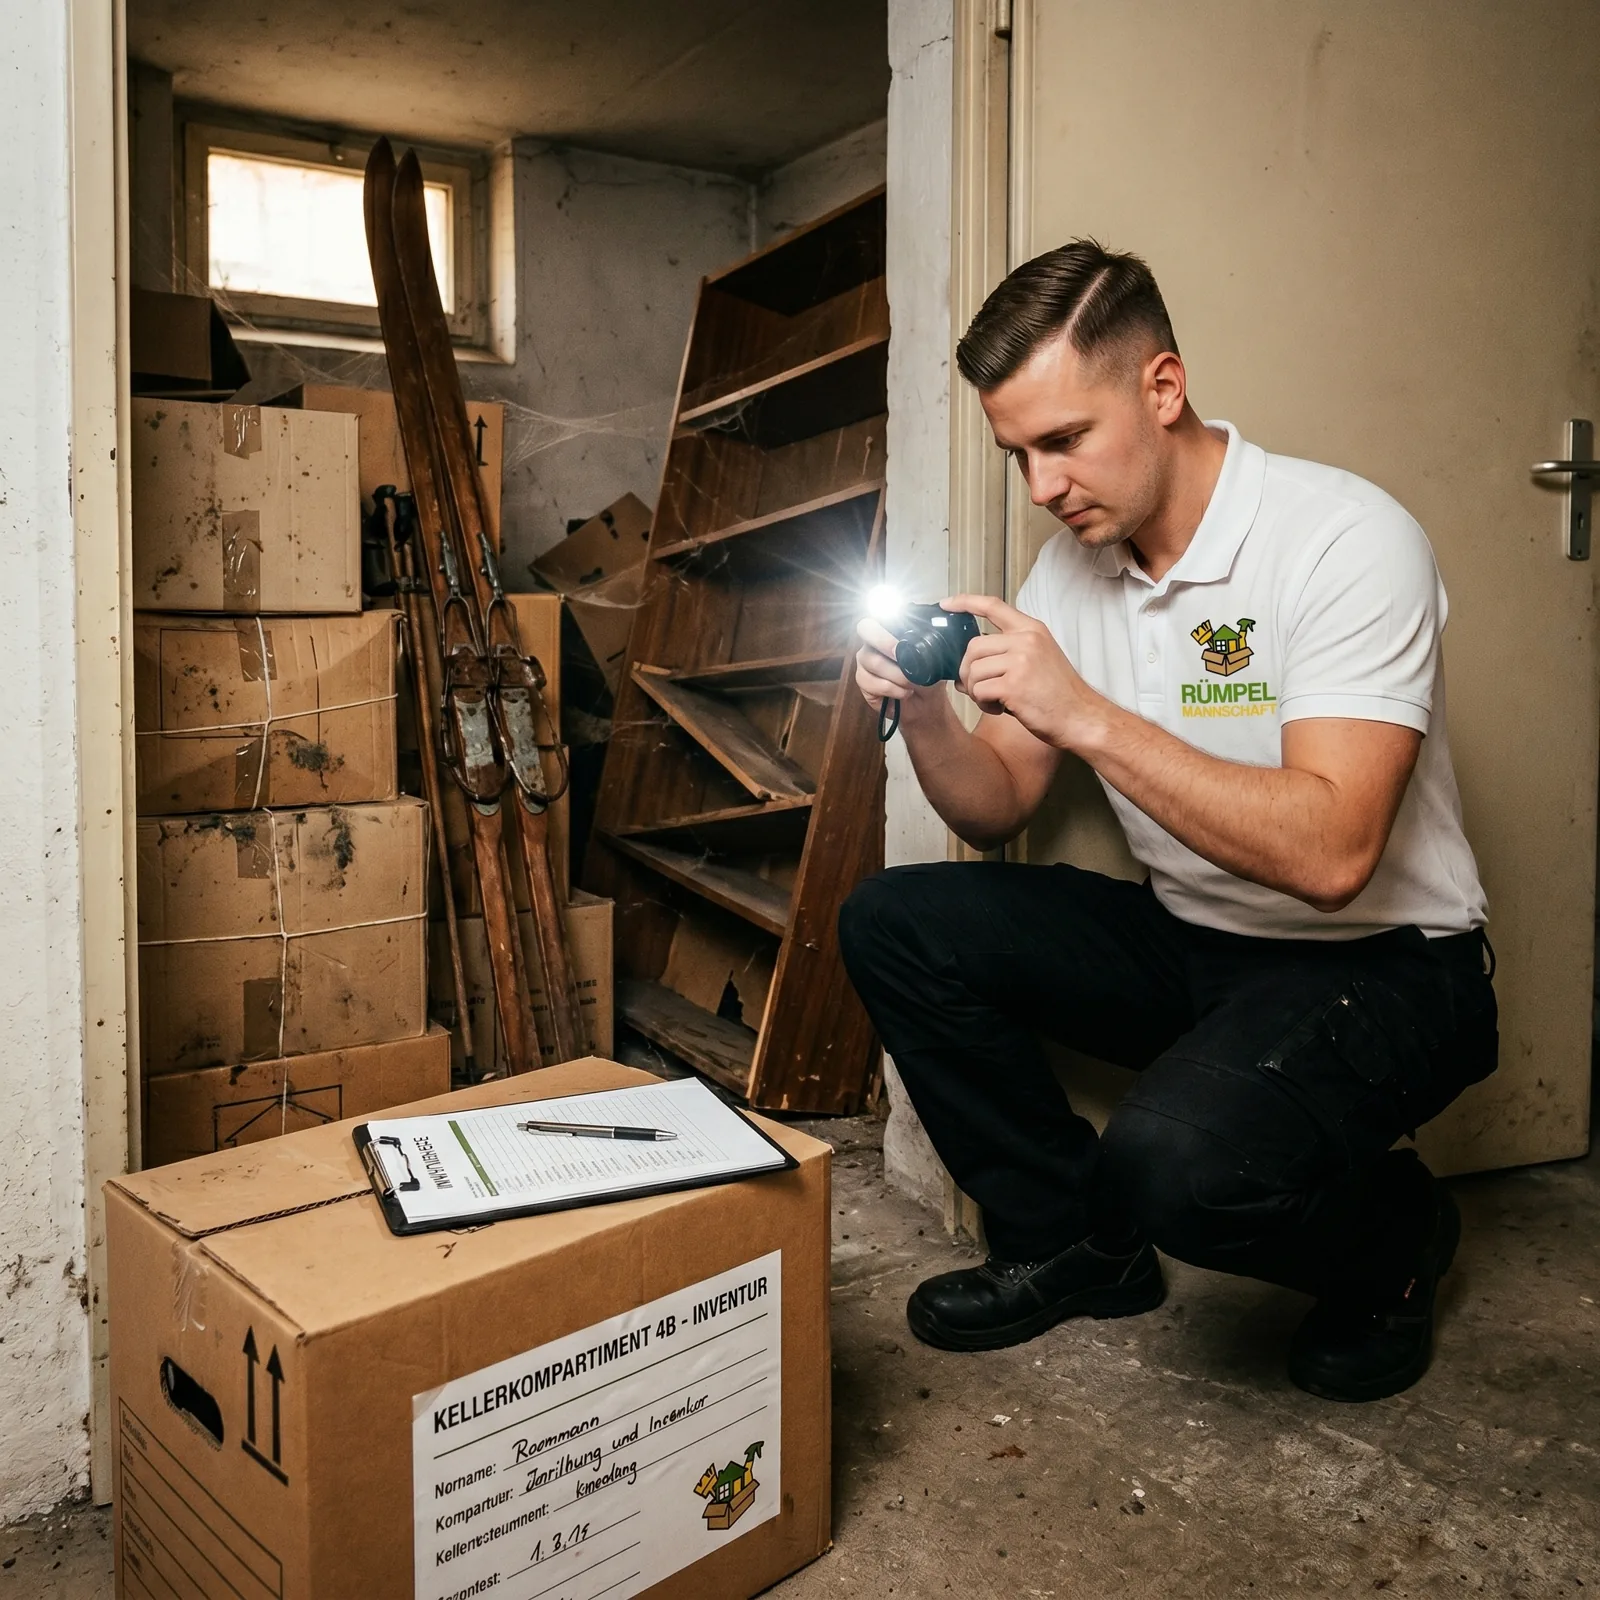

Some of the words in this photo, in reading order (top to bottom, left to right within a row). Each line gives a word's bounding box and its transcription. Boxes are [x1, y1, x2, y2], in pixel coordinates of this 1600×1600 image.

[1181, 679, 1277, 704] RÜMPEL
[1182, 703, 1278, 718] MANNSCHAFT
[433, 1325, 651, 1434] KELLERKOMPARTIMENT
[655, 1315, 677, 1340] 4B
[692, 1276, 768, 1326] INVENTUR
[612, 1423, 639, 1450] und
